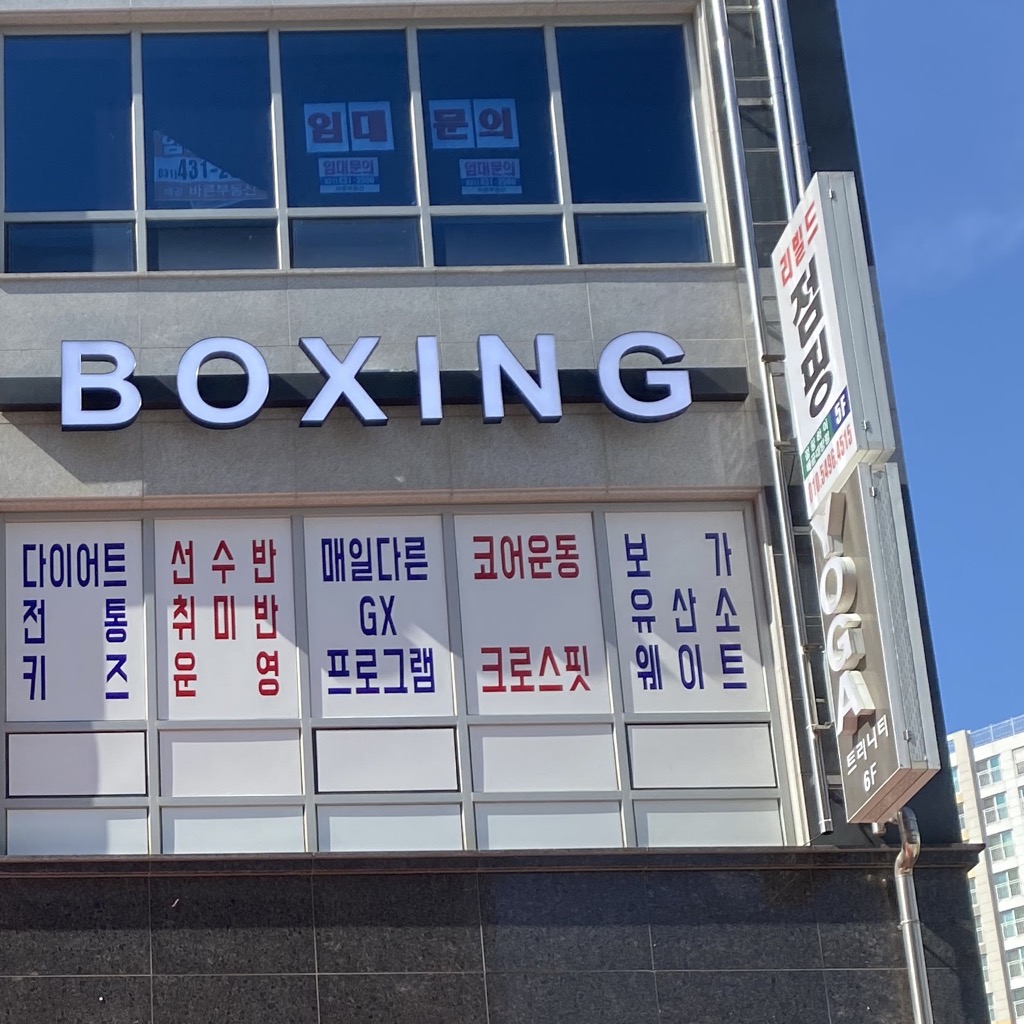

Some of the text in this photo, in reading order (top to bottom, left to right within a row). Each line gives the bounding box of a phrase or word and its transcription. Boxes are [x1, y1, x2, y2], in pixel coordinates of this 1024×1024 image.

[432, 107, 513, 140] 문의
[779, 203, 819, 288] 리빌드
[790, 252, 834, 419] 점핑
[60, 331, 693, 432] BOXING
[834, 393, 849, 426] 5F
[22, 542, 127, 588] 다이어트
[171, 539, 277, 585] 선수반
[321, 536, 428, 582] 매일다른
[473, 534, 580, 580] 코어운동
[172, 594, 279, 641] 취미반
[359, 595, 398, 636] GX
[630, 587, 741, 634] 유산소
[810, 492, 875, 736] YOGA
[327, 647, 436, 695] 프로그램
[480, 645, 591, 693] 크로스핏
[636, 643, 748, 691] 웨이트
[846, 714, 889, 776] 트리니티
[863, 761, 877, 793] 6F
